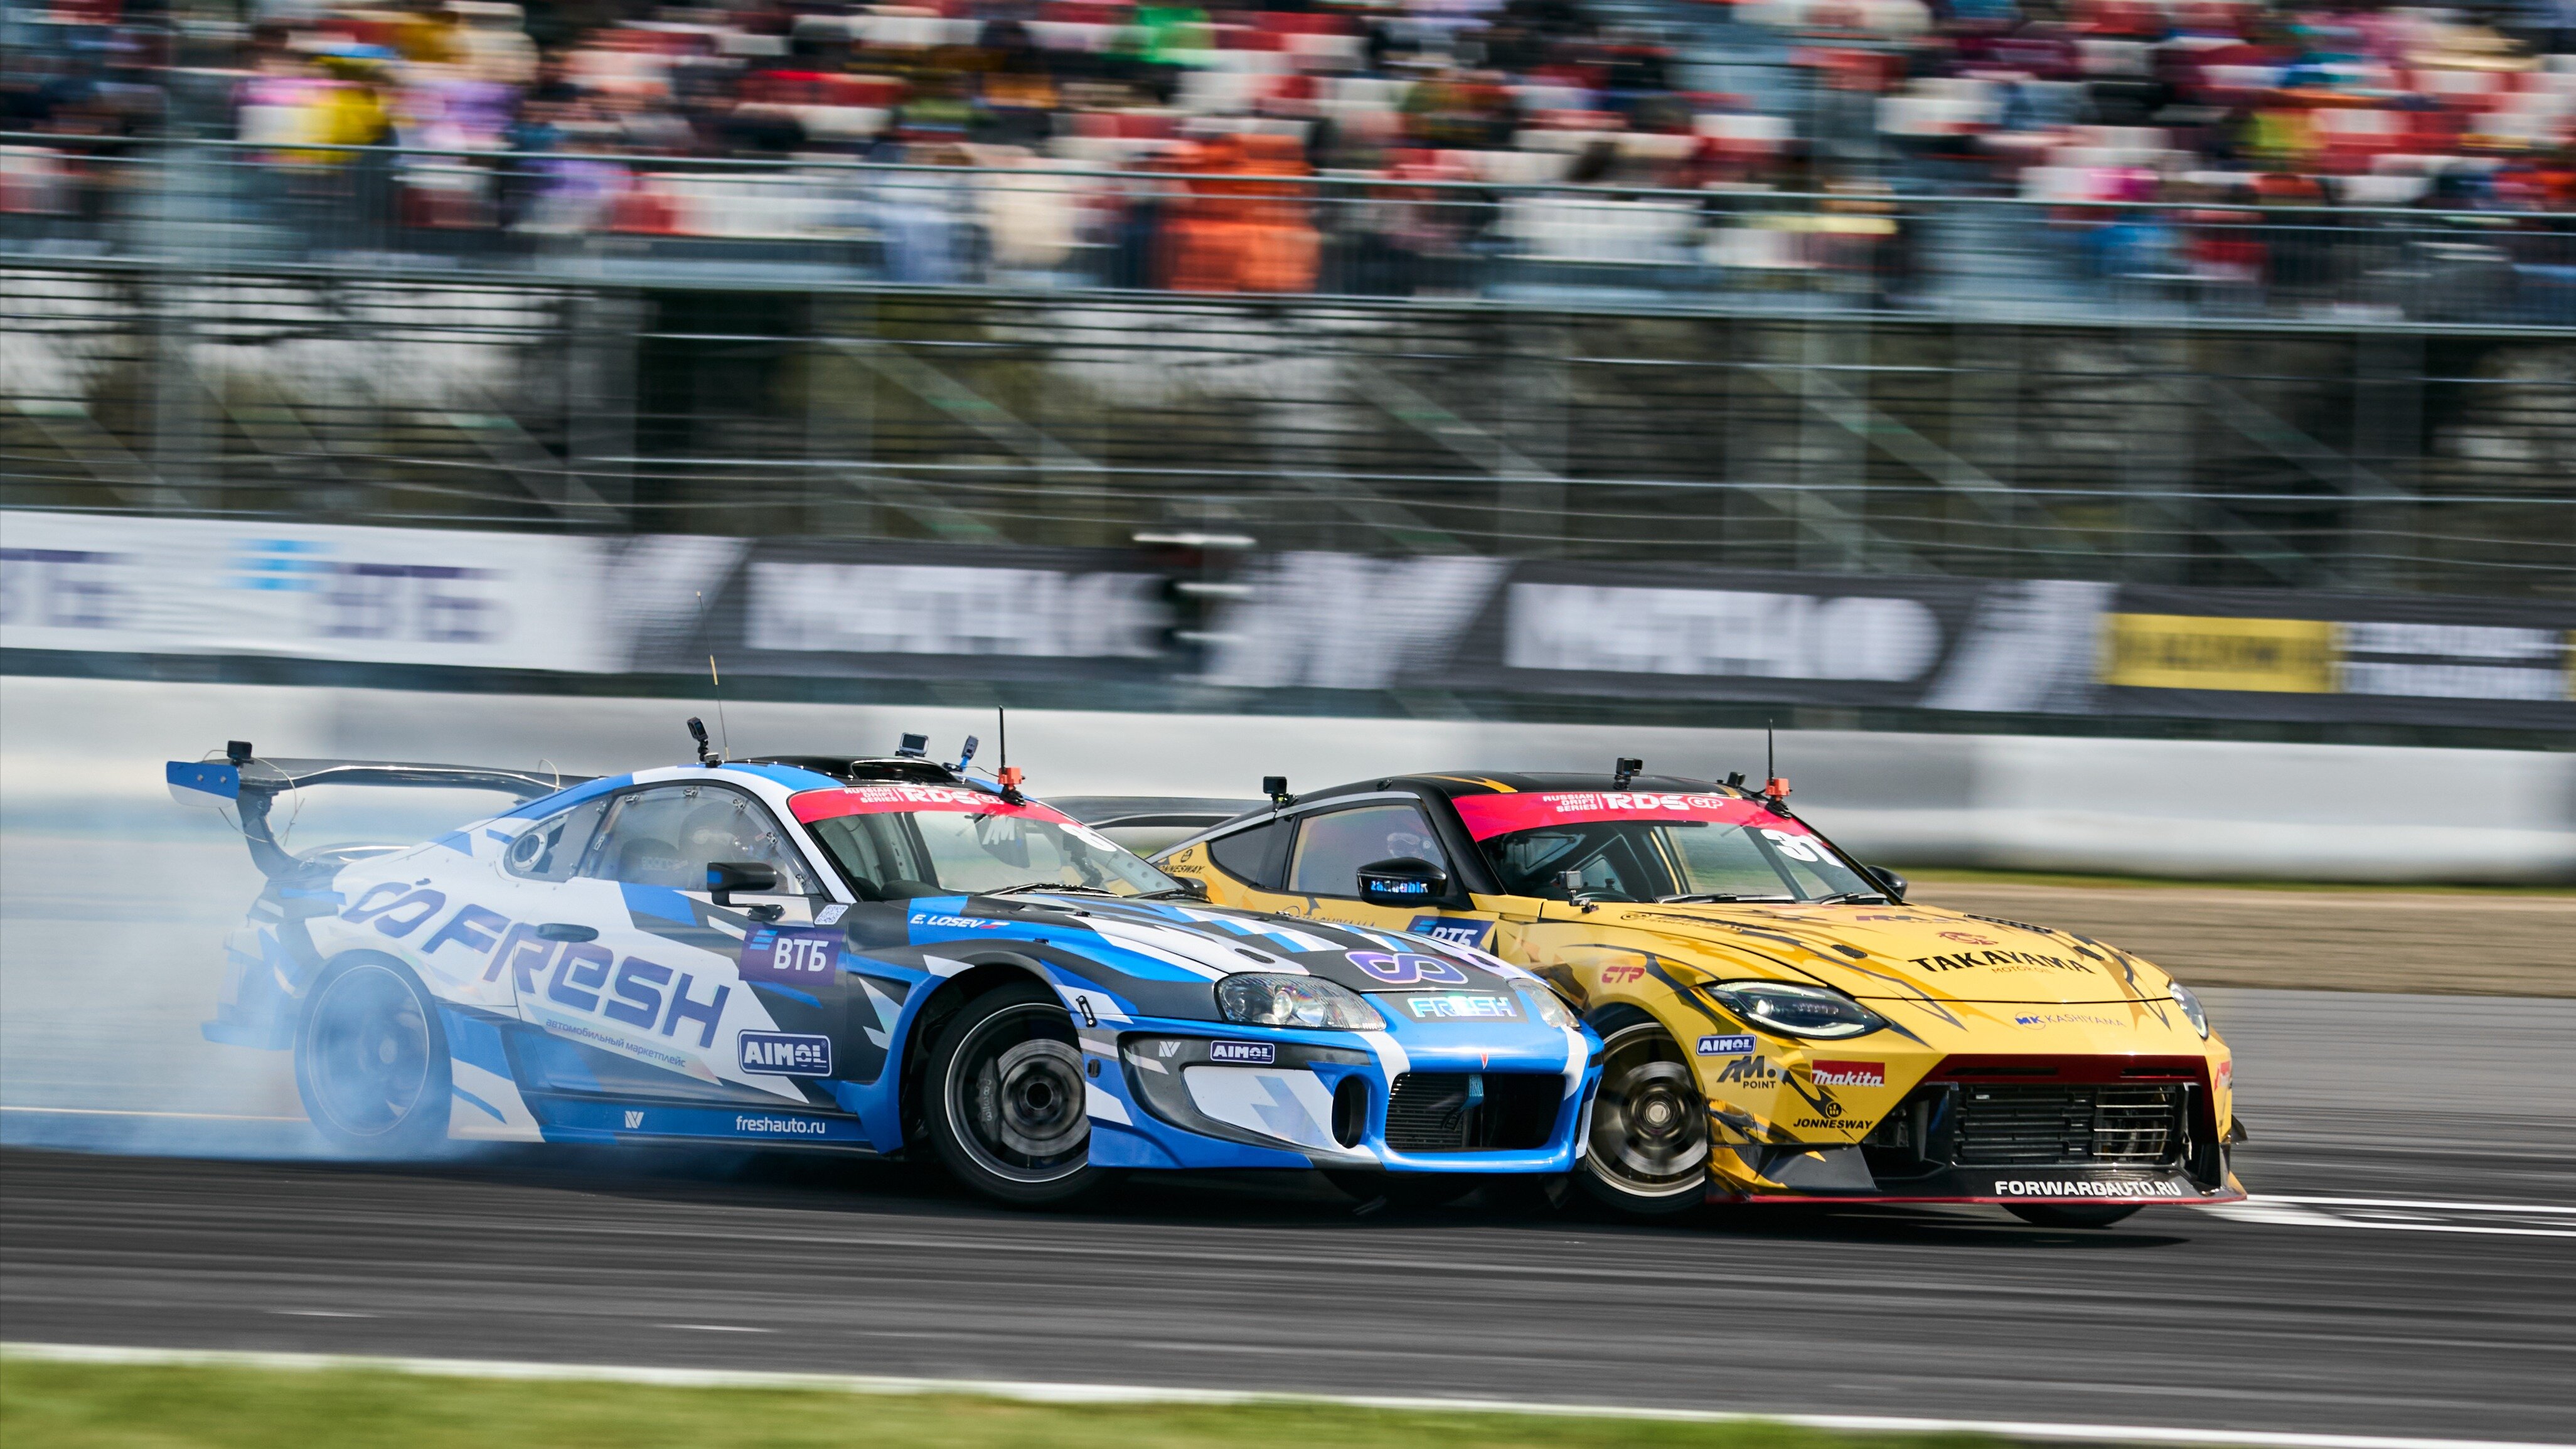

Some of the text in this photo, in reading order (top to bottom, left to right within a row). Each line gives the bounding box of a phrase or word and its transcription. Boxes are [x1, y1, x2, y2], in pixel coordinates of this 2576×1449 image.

[897, 788, 981, 805] RDS
[1542, 793, 1595, 802] RUSSIAN
[1601, 793, 1690, 811] RDS
[1687, 796, 1723, 809] GP
[1556, 804, 1598, 812] SERIES
[1760, 828, 1844, 868] 31
[910, 914, 985, 929] E. LOSEV
[773, 938, 830, 972] ВТБ
[1908, 950, 2097, 975] TAKAYAMA
[1991, 966, 2031, 974] MOTOR
[2016, 1014, 2127, 1028] MK KASHIYAMA
[545, 1017, 686, 1068] автомобильный маркетплейс
[1743, 1081, 1776, 1089] POINT
[735, 1115, 825, 1134] freshauto.ru
[1793, 1118, 1874, 1130] JONNESWAY
[1994, 1181, 2182, 1196] FORWARDAUTO.RU
